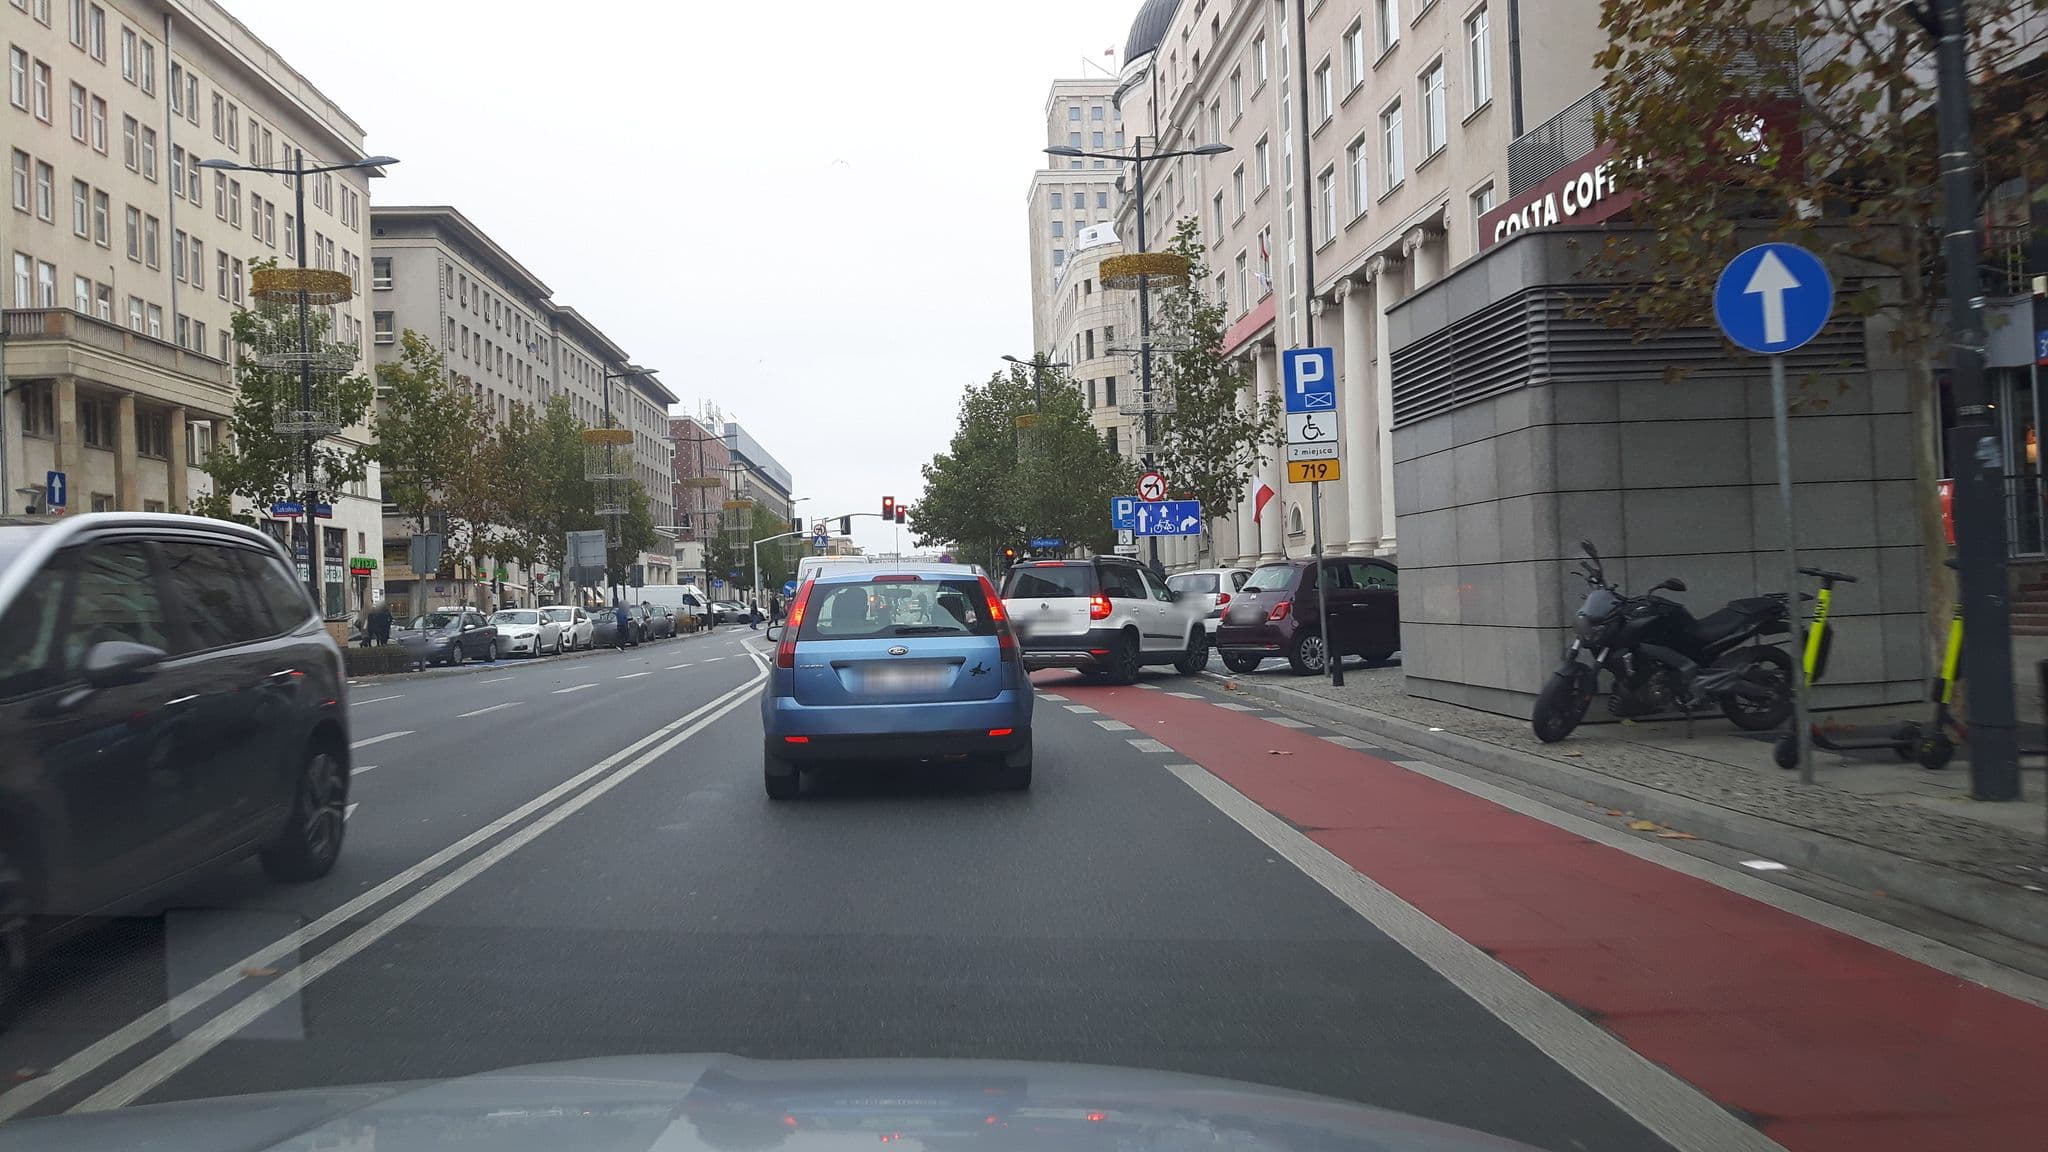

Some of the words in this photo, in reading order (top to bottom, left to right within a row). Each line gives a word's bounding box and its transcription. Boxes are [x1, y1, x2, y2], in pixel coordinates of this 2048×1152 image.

[1294, 353, 1324, 394] P
[1293, 448, 1299, 456] 2
[1301, 448, 1333, 456] miejsca
[1301, 463, 1327, 479] 719
[1117, 499, 1132, 520] P
